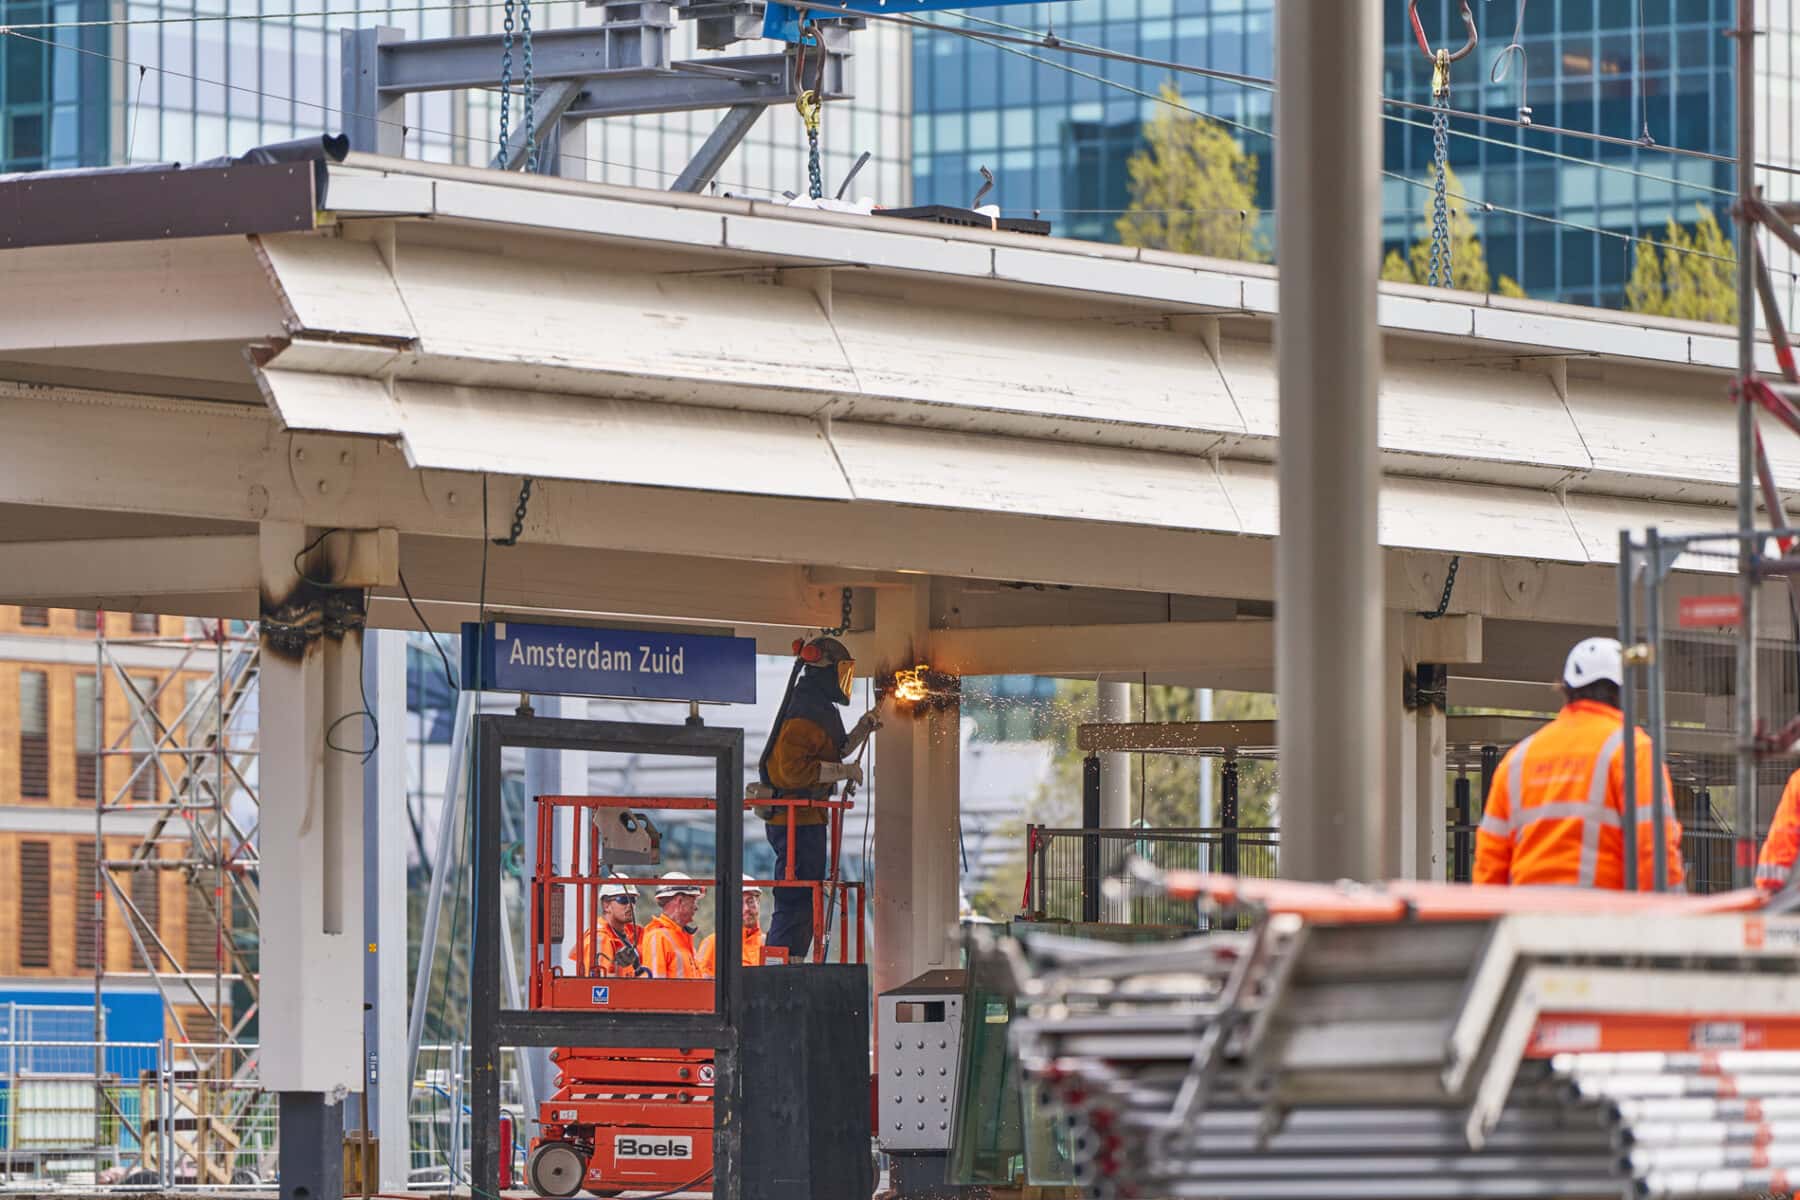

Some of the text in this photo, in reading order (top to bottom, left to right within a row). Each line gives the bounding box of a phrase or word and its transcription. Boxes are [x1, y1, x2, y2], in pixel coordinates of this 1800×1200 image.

[509, 638, 685, 675] Amsterdam Zuid
[618, 1139, 688, 1157] Boels
